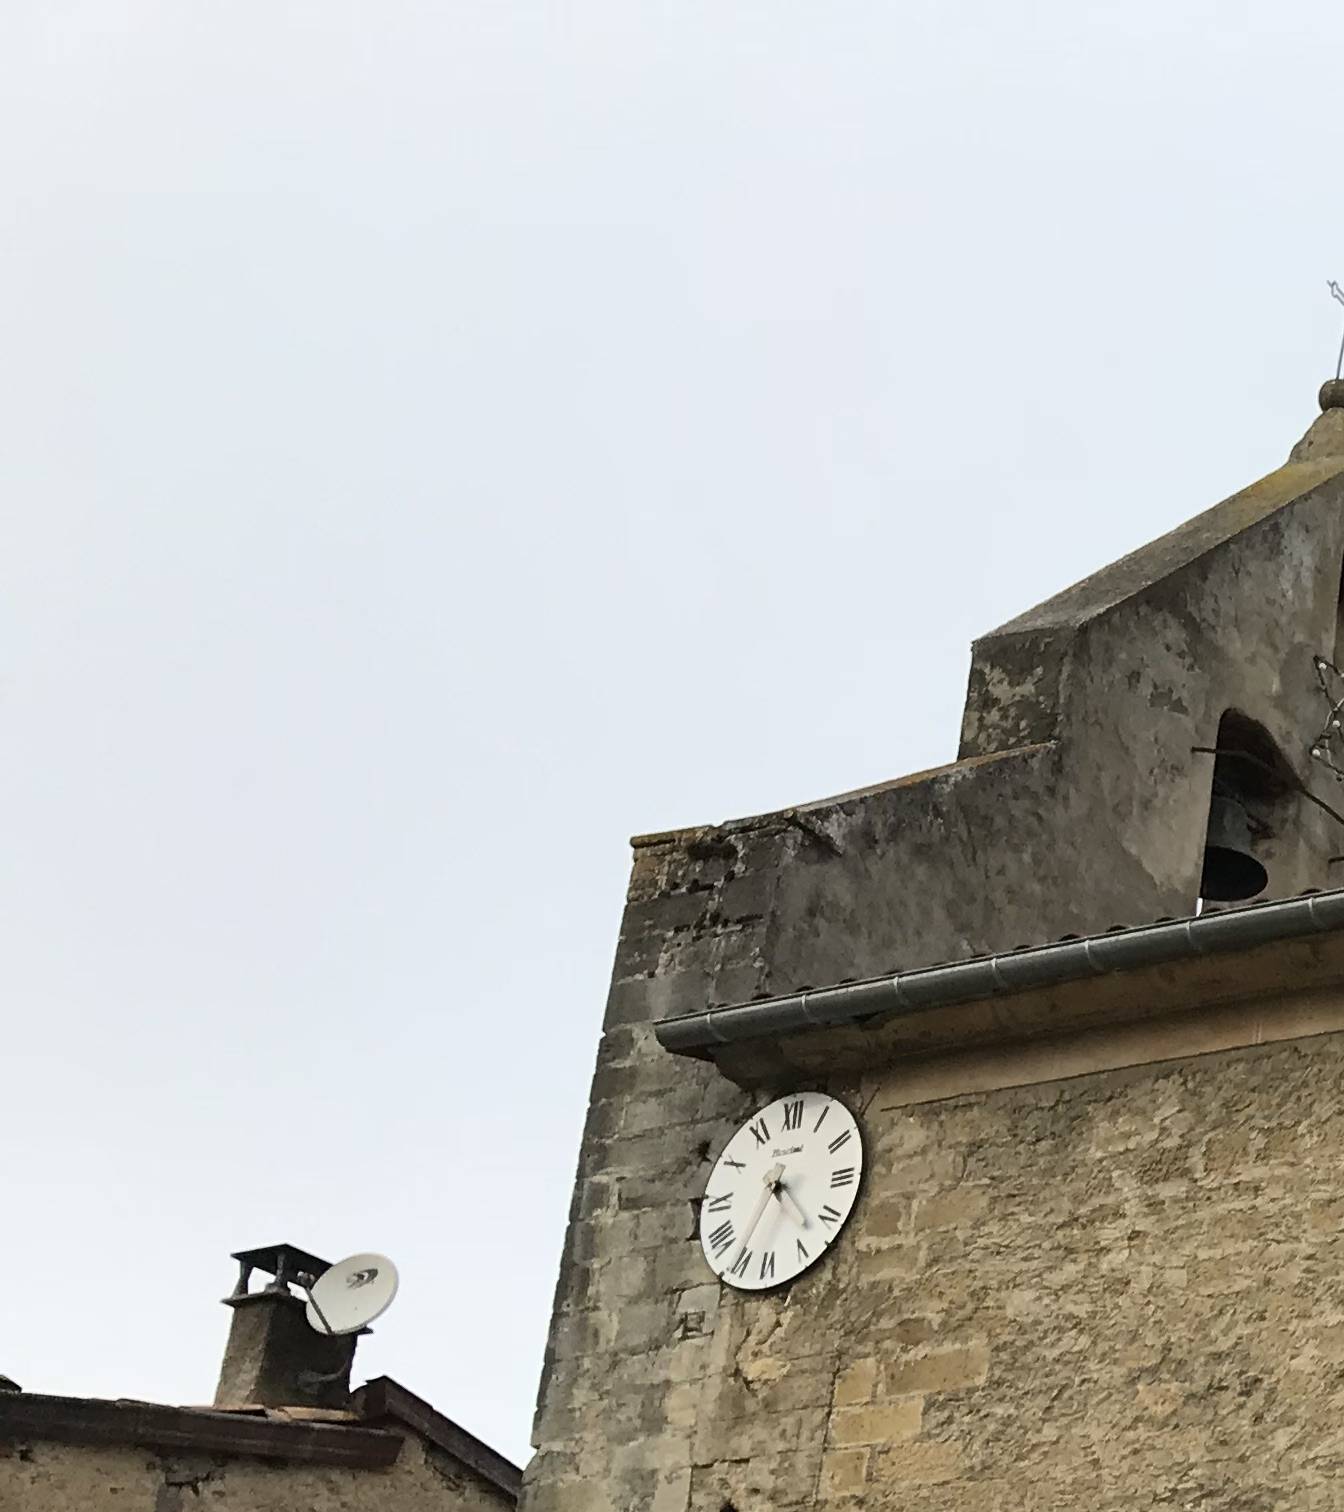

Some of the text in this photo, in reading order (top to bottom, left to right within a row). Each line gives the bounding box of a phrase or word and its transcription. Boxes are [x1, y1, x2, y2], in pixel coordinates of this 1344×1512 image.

[781, 1100, 804, 1132] XII
[813, 1105, 829, 1133] I
[749, 1118, 771, 1150] XI
[828, 1130, 852, 1154] II
[723, 1154, 746, 1174] X
[830, 1167, 855, 1188] III
[708, 1192, 734, 1213] IX
[818, 1205, 841, 1230] IV
[708, 1220, 736, 1259] VIII
[797, 1238, 809, 1262] V
[759, 1251, 775, 1280] VI
